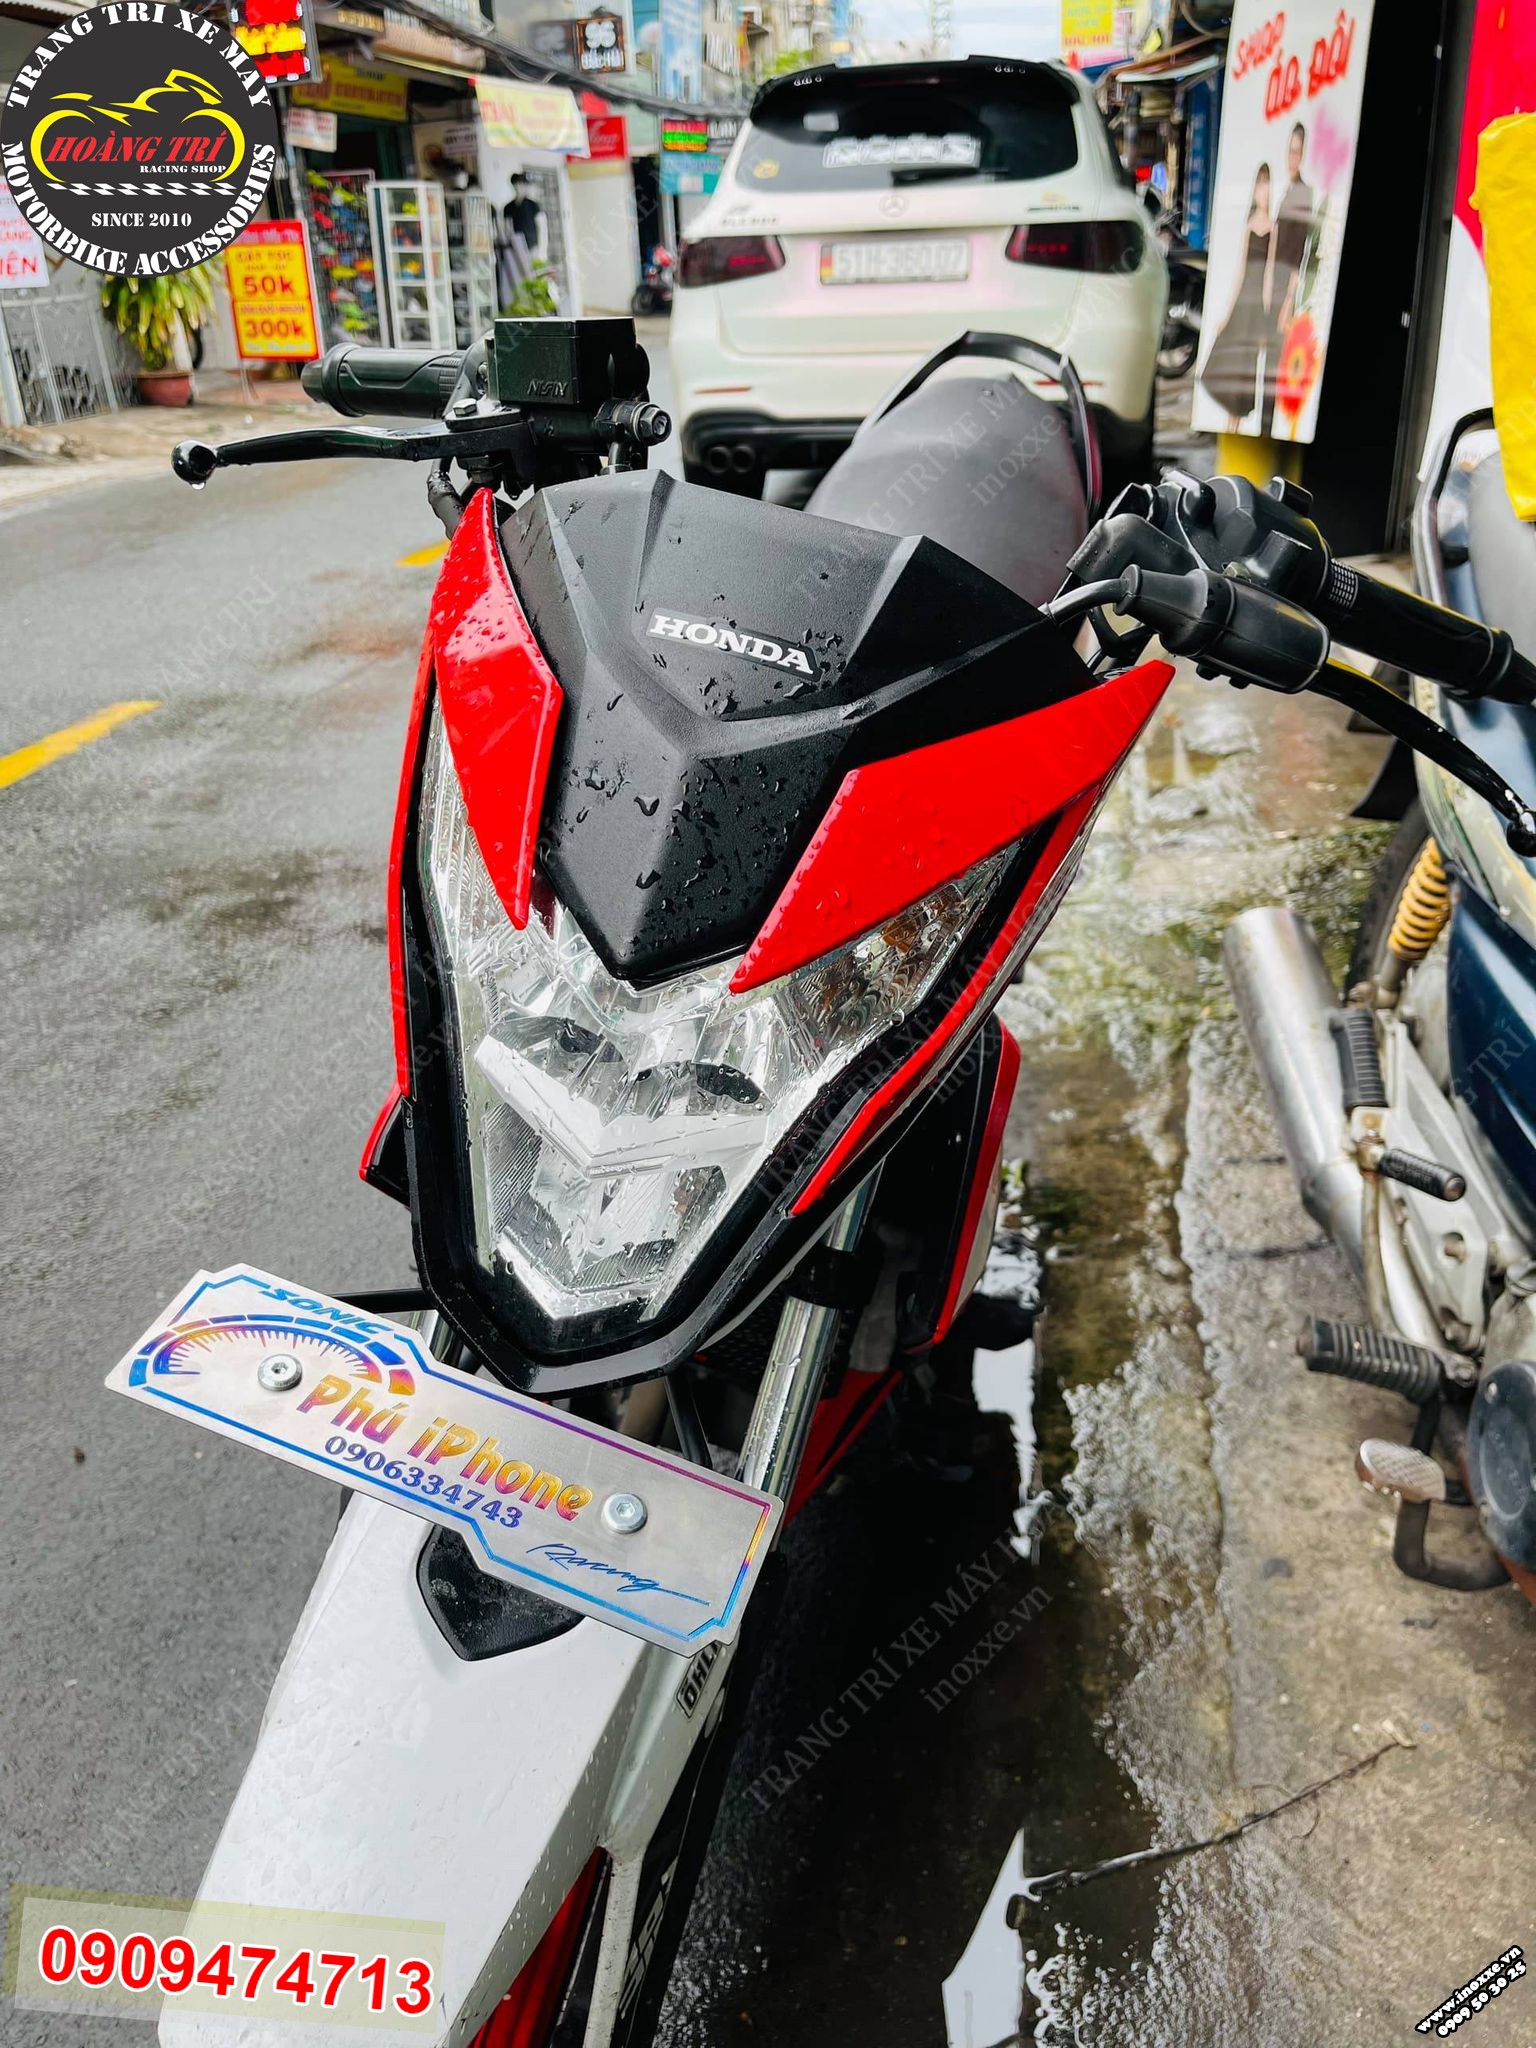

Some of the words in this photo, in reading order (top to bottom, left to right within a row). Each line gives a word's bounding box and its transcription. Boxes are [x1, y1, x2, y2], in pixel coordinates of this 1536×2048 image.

[650, 614, 814, 675] HONDA
[260, 1287, 395, 1335] SONIC
[296, 1374, 409, 1444] Phú
[406, 1416, 593, 1521] iPhone
[325, 1436, 523, 1528] 0906334743
